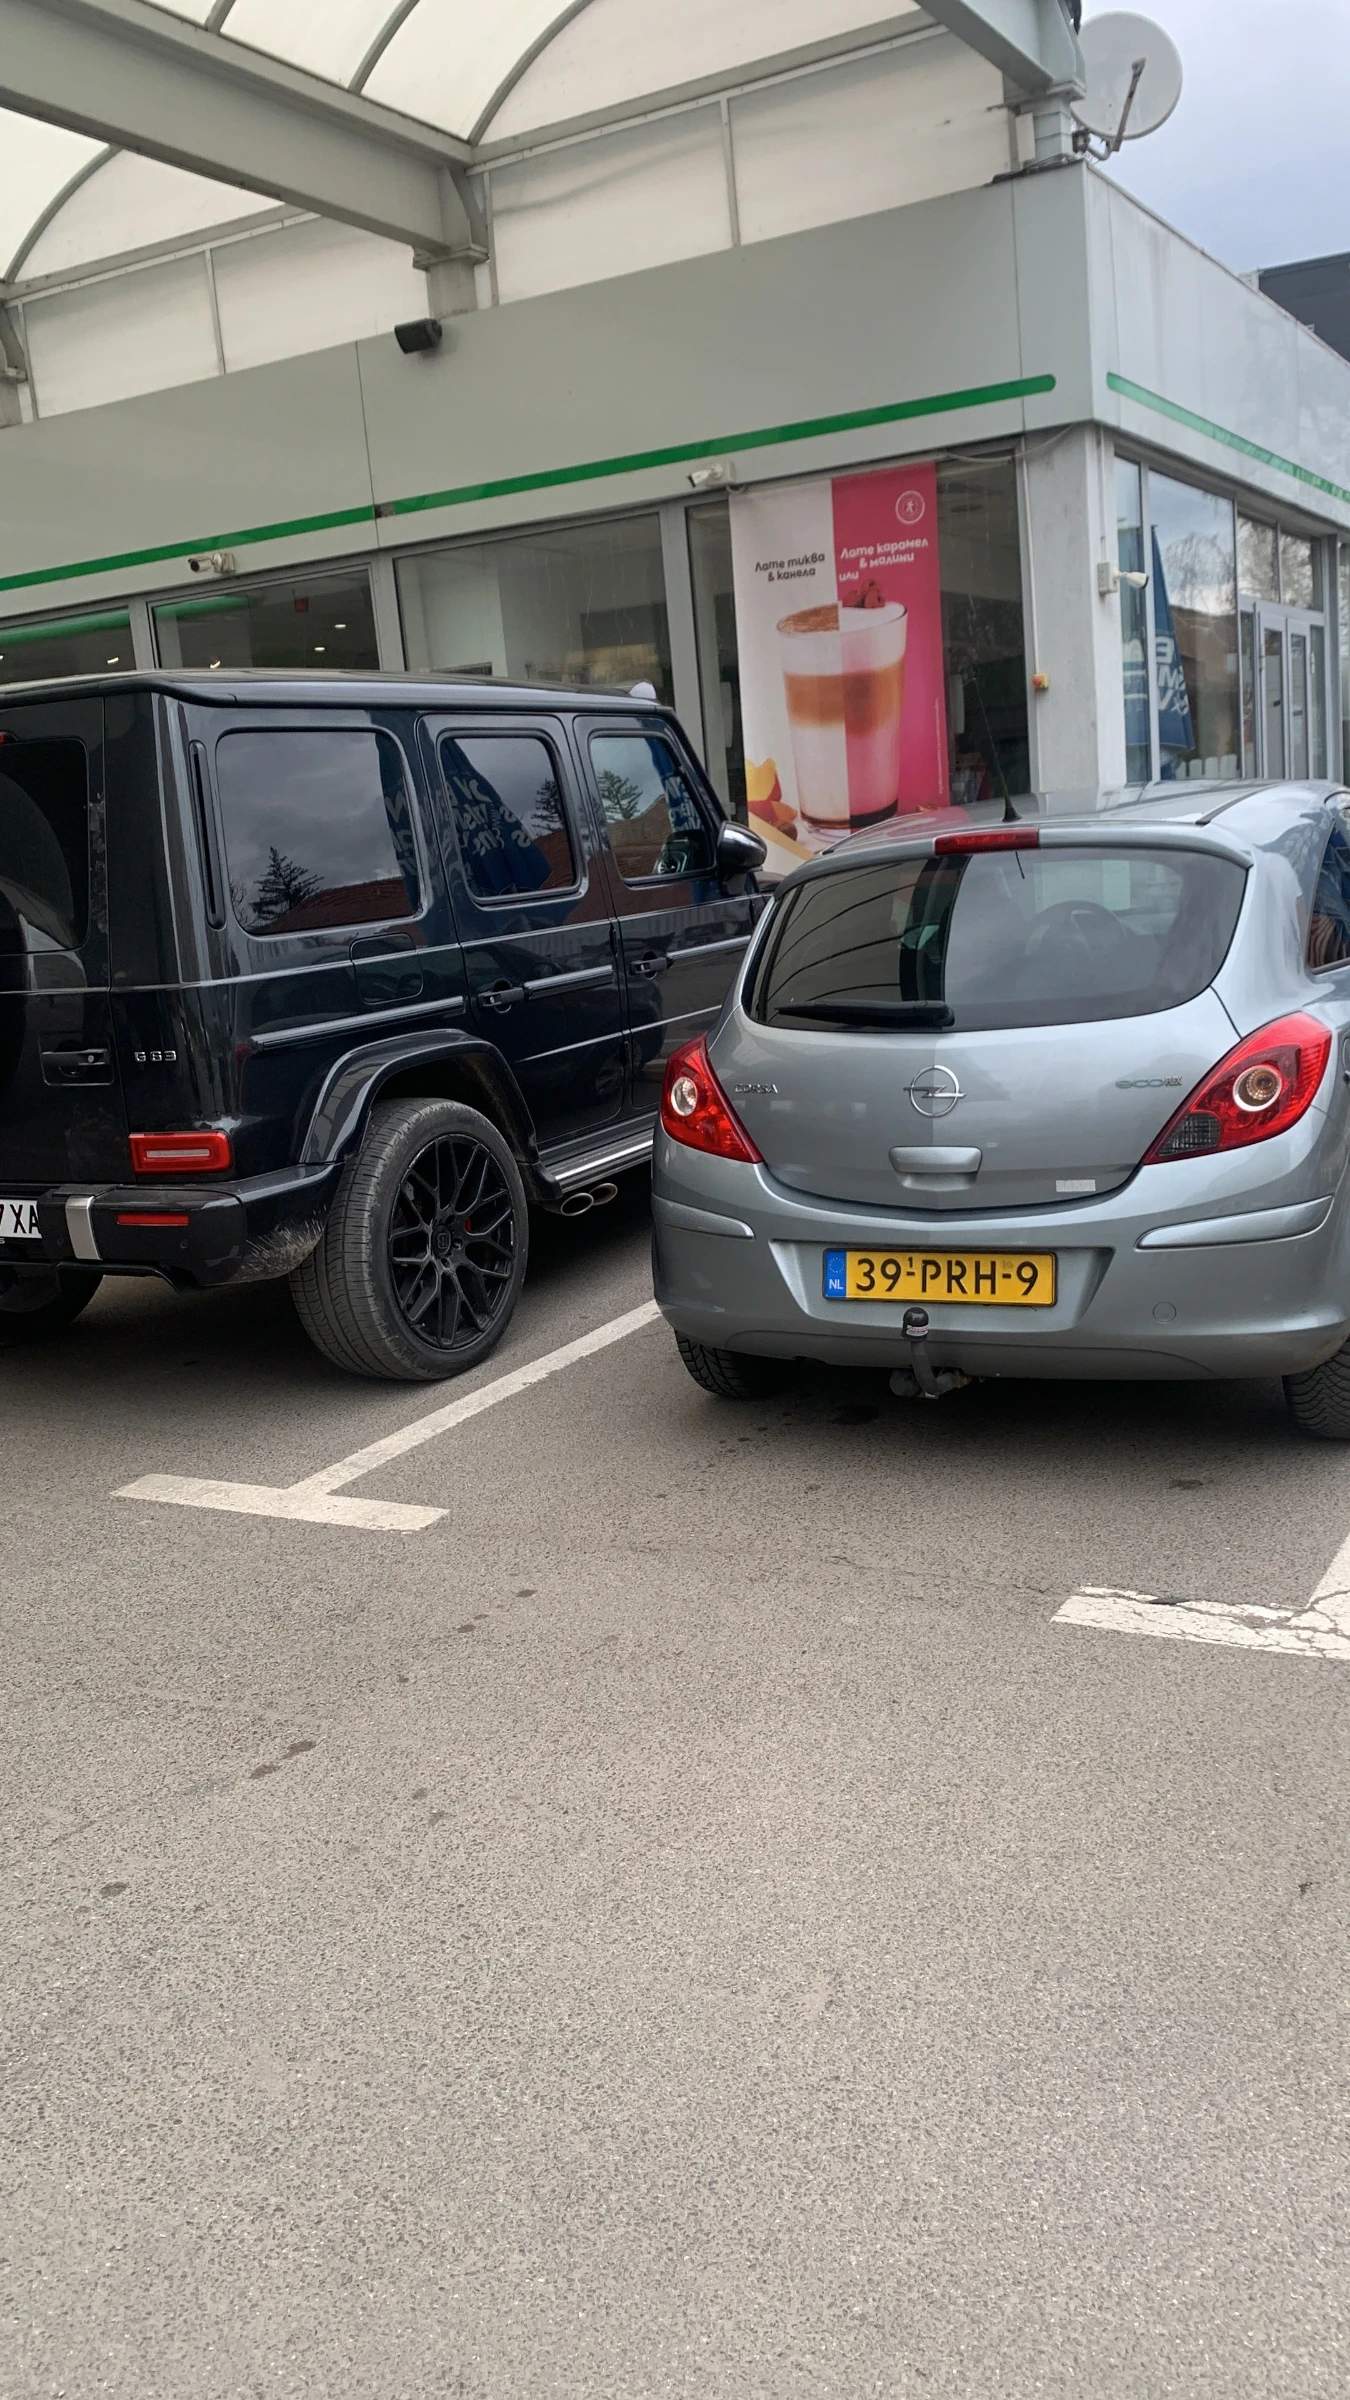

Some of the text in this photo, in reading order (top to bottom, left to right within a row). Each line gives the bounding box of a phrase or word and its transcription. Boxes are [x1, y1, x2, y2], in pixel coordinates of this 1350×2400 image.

[840, 538, 929, 560] Лате карамел
[754, 552, 826, 573] Лате тиква
[859, 552, 915, 569] & малини
[767, 567, 816, 582] & канела
[838, 571, 860, 582] или
[828, 1278, 844, 1290] NL
